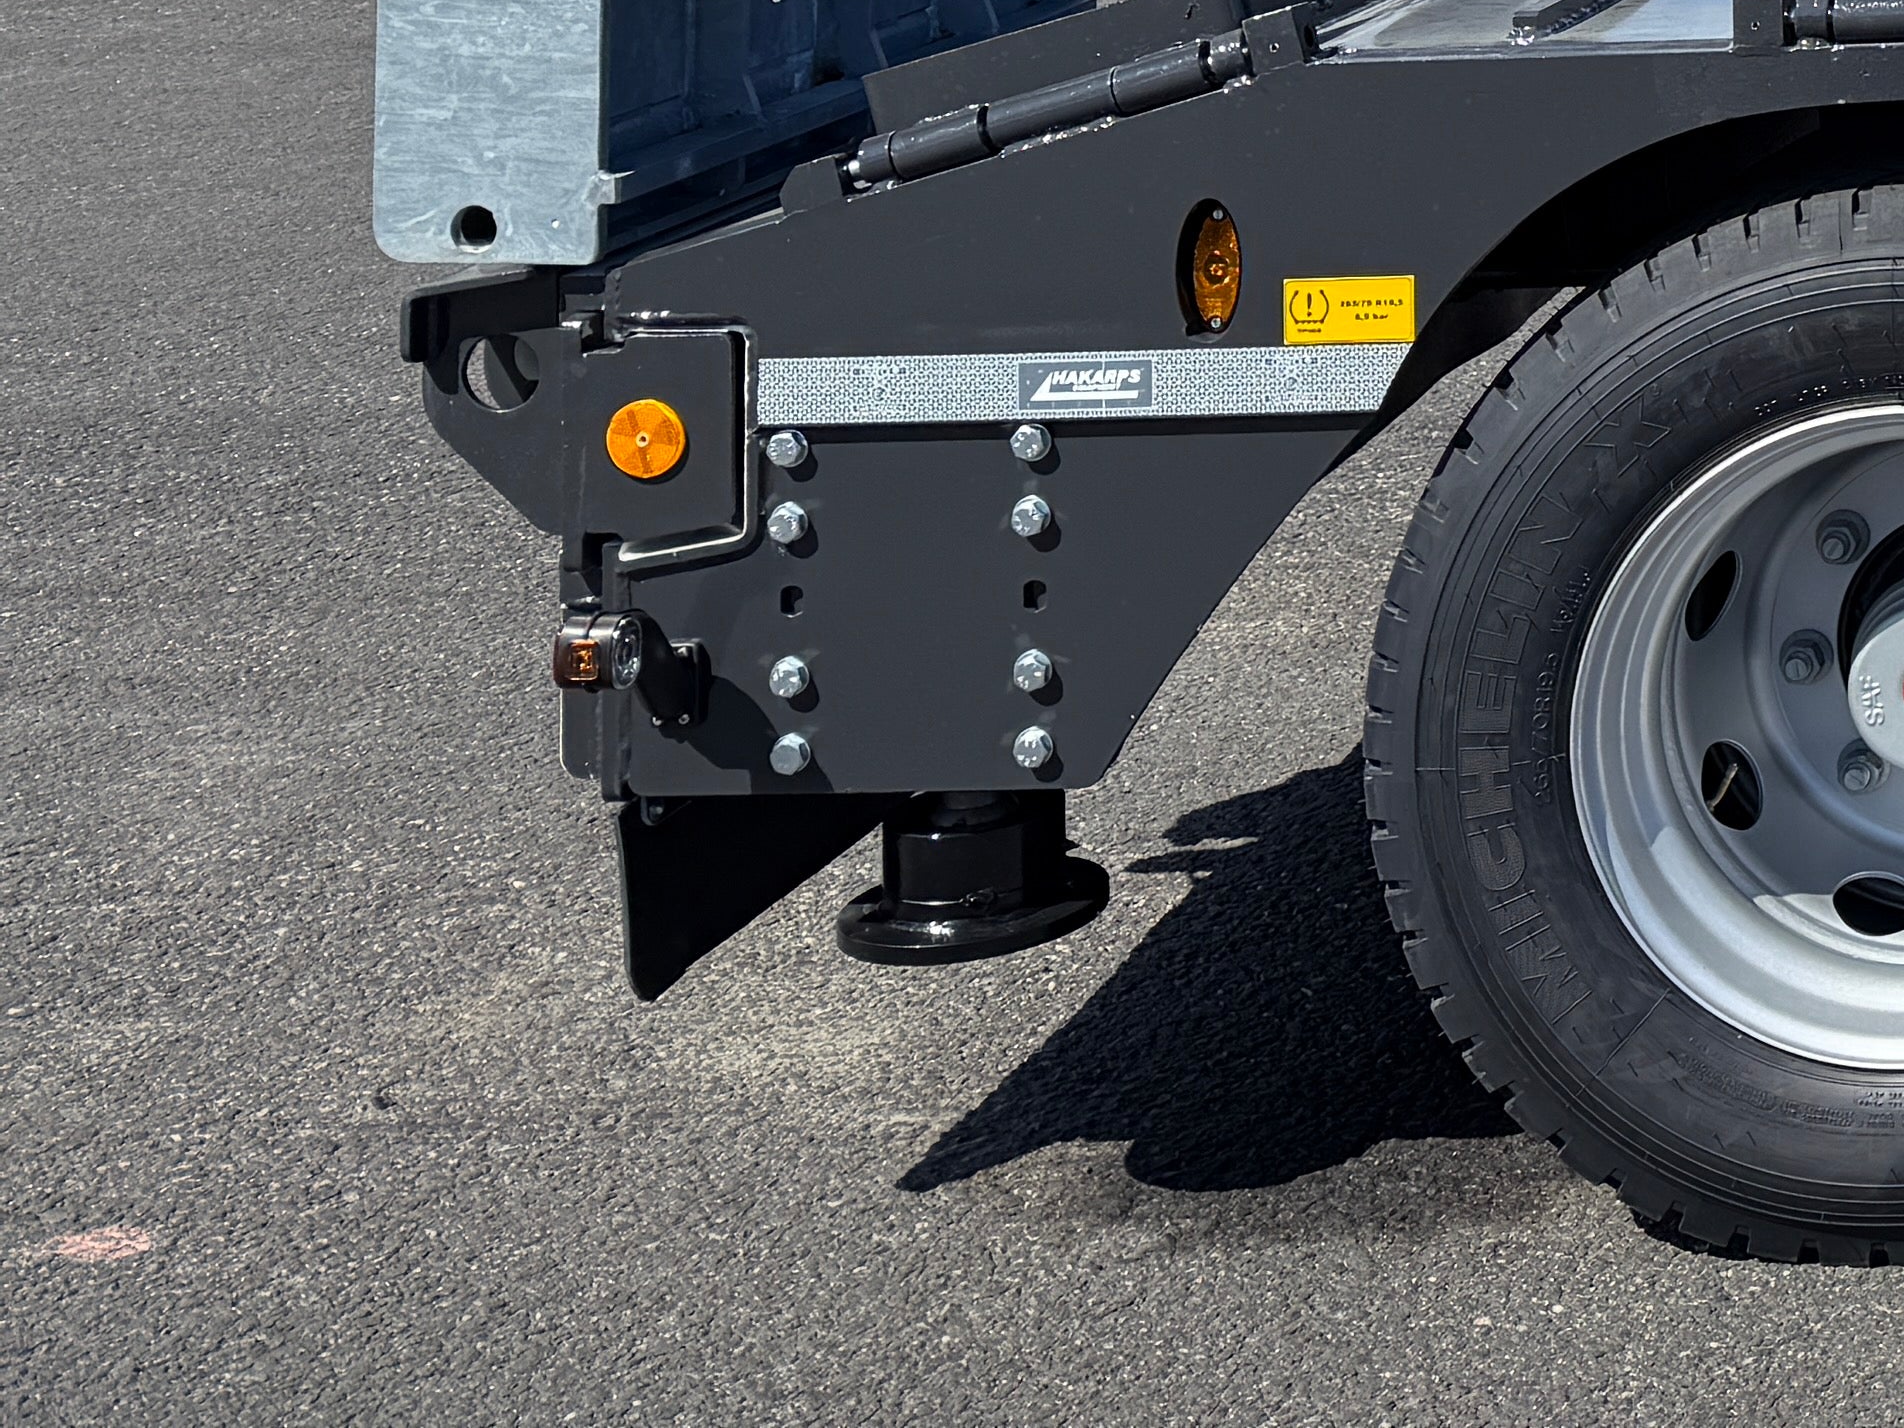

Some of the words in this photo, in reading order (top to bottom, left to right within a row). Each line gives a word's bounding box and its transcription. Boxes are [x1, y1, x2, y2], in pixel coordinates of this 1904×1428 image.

[1051, 368, 1142, 385] HAKARPS
[1858, 675, 1885, 727] SAF
[1460, 491, 1597, 1026] MICHELIN
